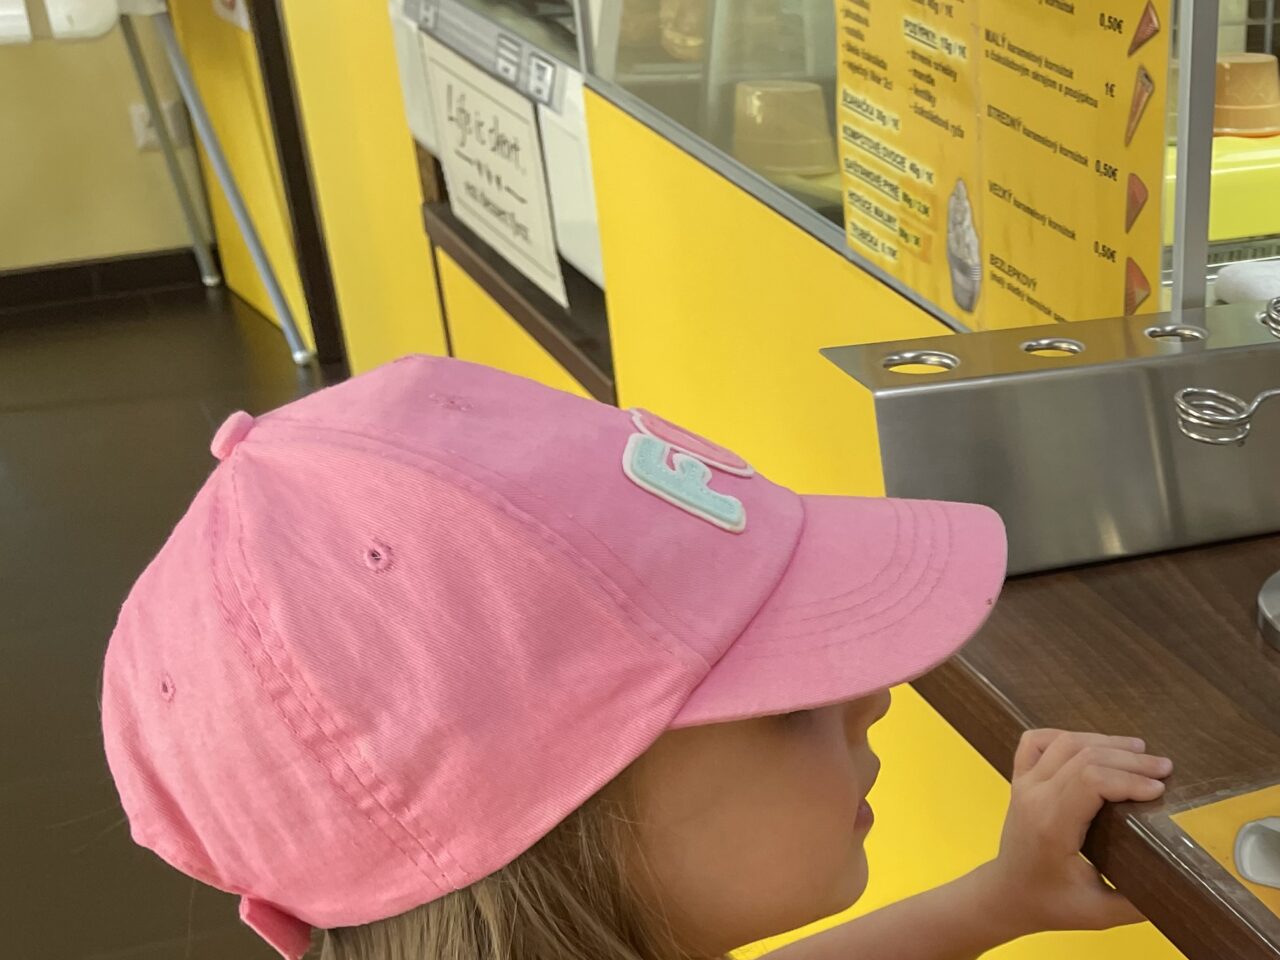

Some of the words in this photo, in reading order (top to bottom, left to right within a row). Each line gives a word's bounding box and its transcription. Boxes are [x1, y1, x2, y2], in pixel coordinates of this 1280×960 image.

[1099, 12, 1124, 34] 0,50€
[1095, 158, 1119, 182] 0,50€
[1093, 240, 1117, 264] 0,50€
